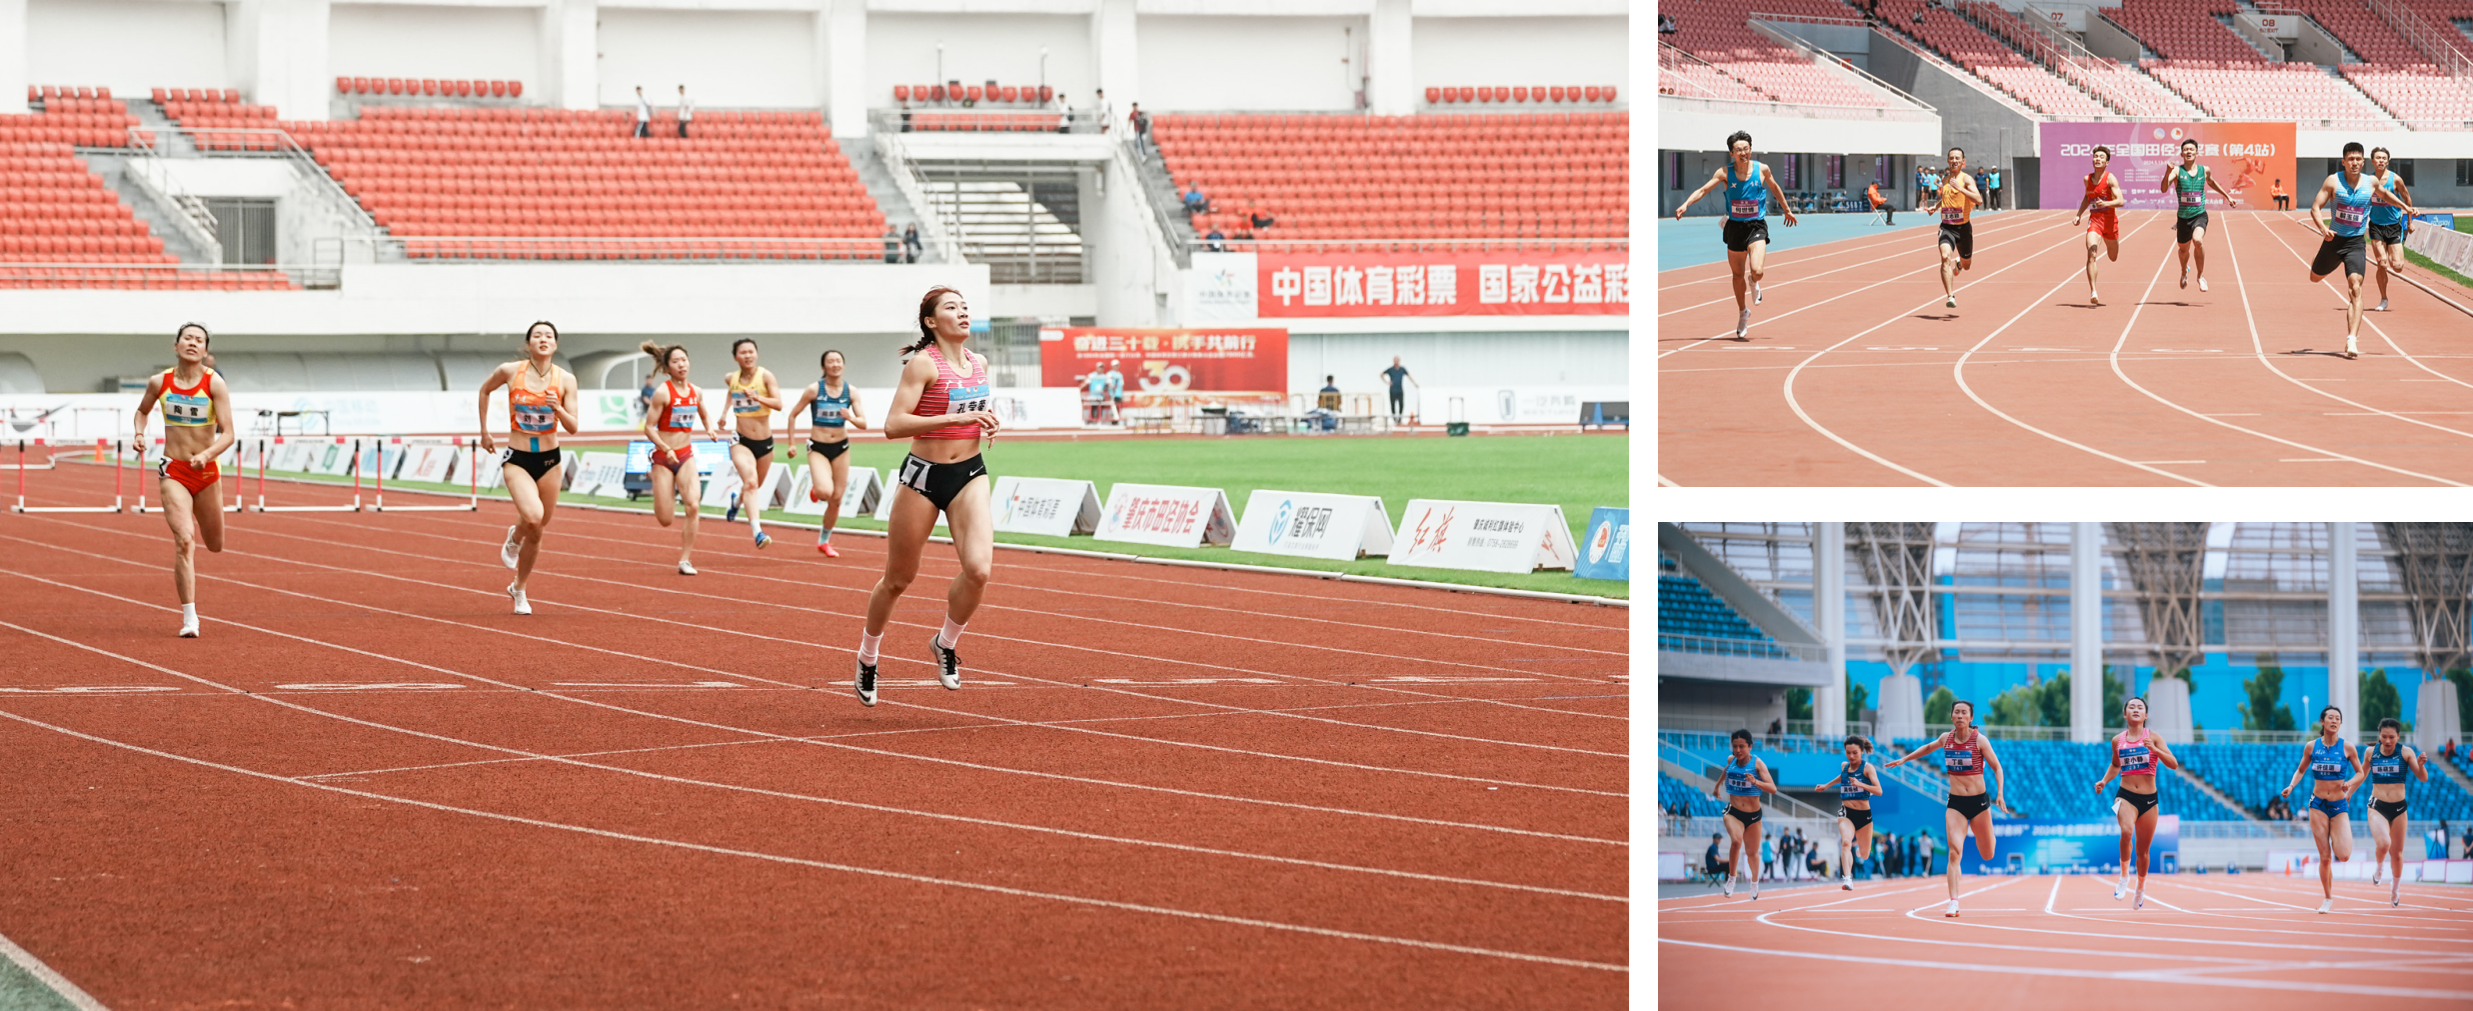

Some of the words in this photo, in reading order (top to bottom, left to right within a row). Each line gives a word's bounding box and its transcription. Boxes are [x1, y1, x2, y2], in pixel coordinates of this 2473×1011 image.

[2051, 12, 2063, 20] 07
[2262, 18, 2275, 27] 08
[1271, 265, 1457, 306] 中国体育彩票
[1479, 263, 1629, 304] 国家公益彩
[907, 460, 926, 489] 7
[1122, 497, 1199, 534] 肇庆市田径协会
[1408, 506, 1455, 554] 红旗
[2124, 755, 2144, 765] 梁小静
